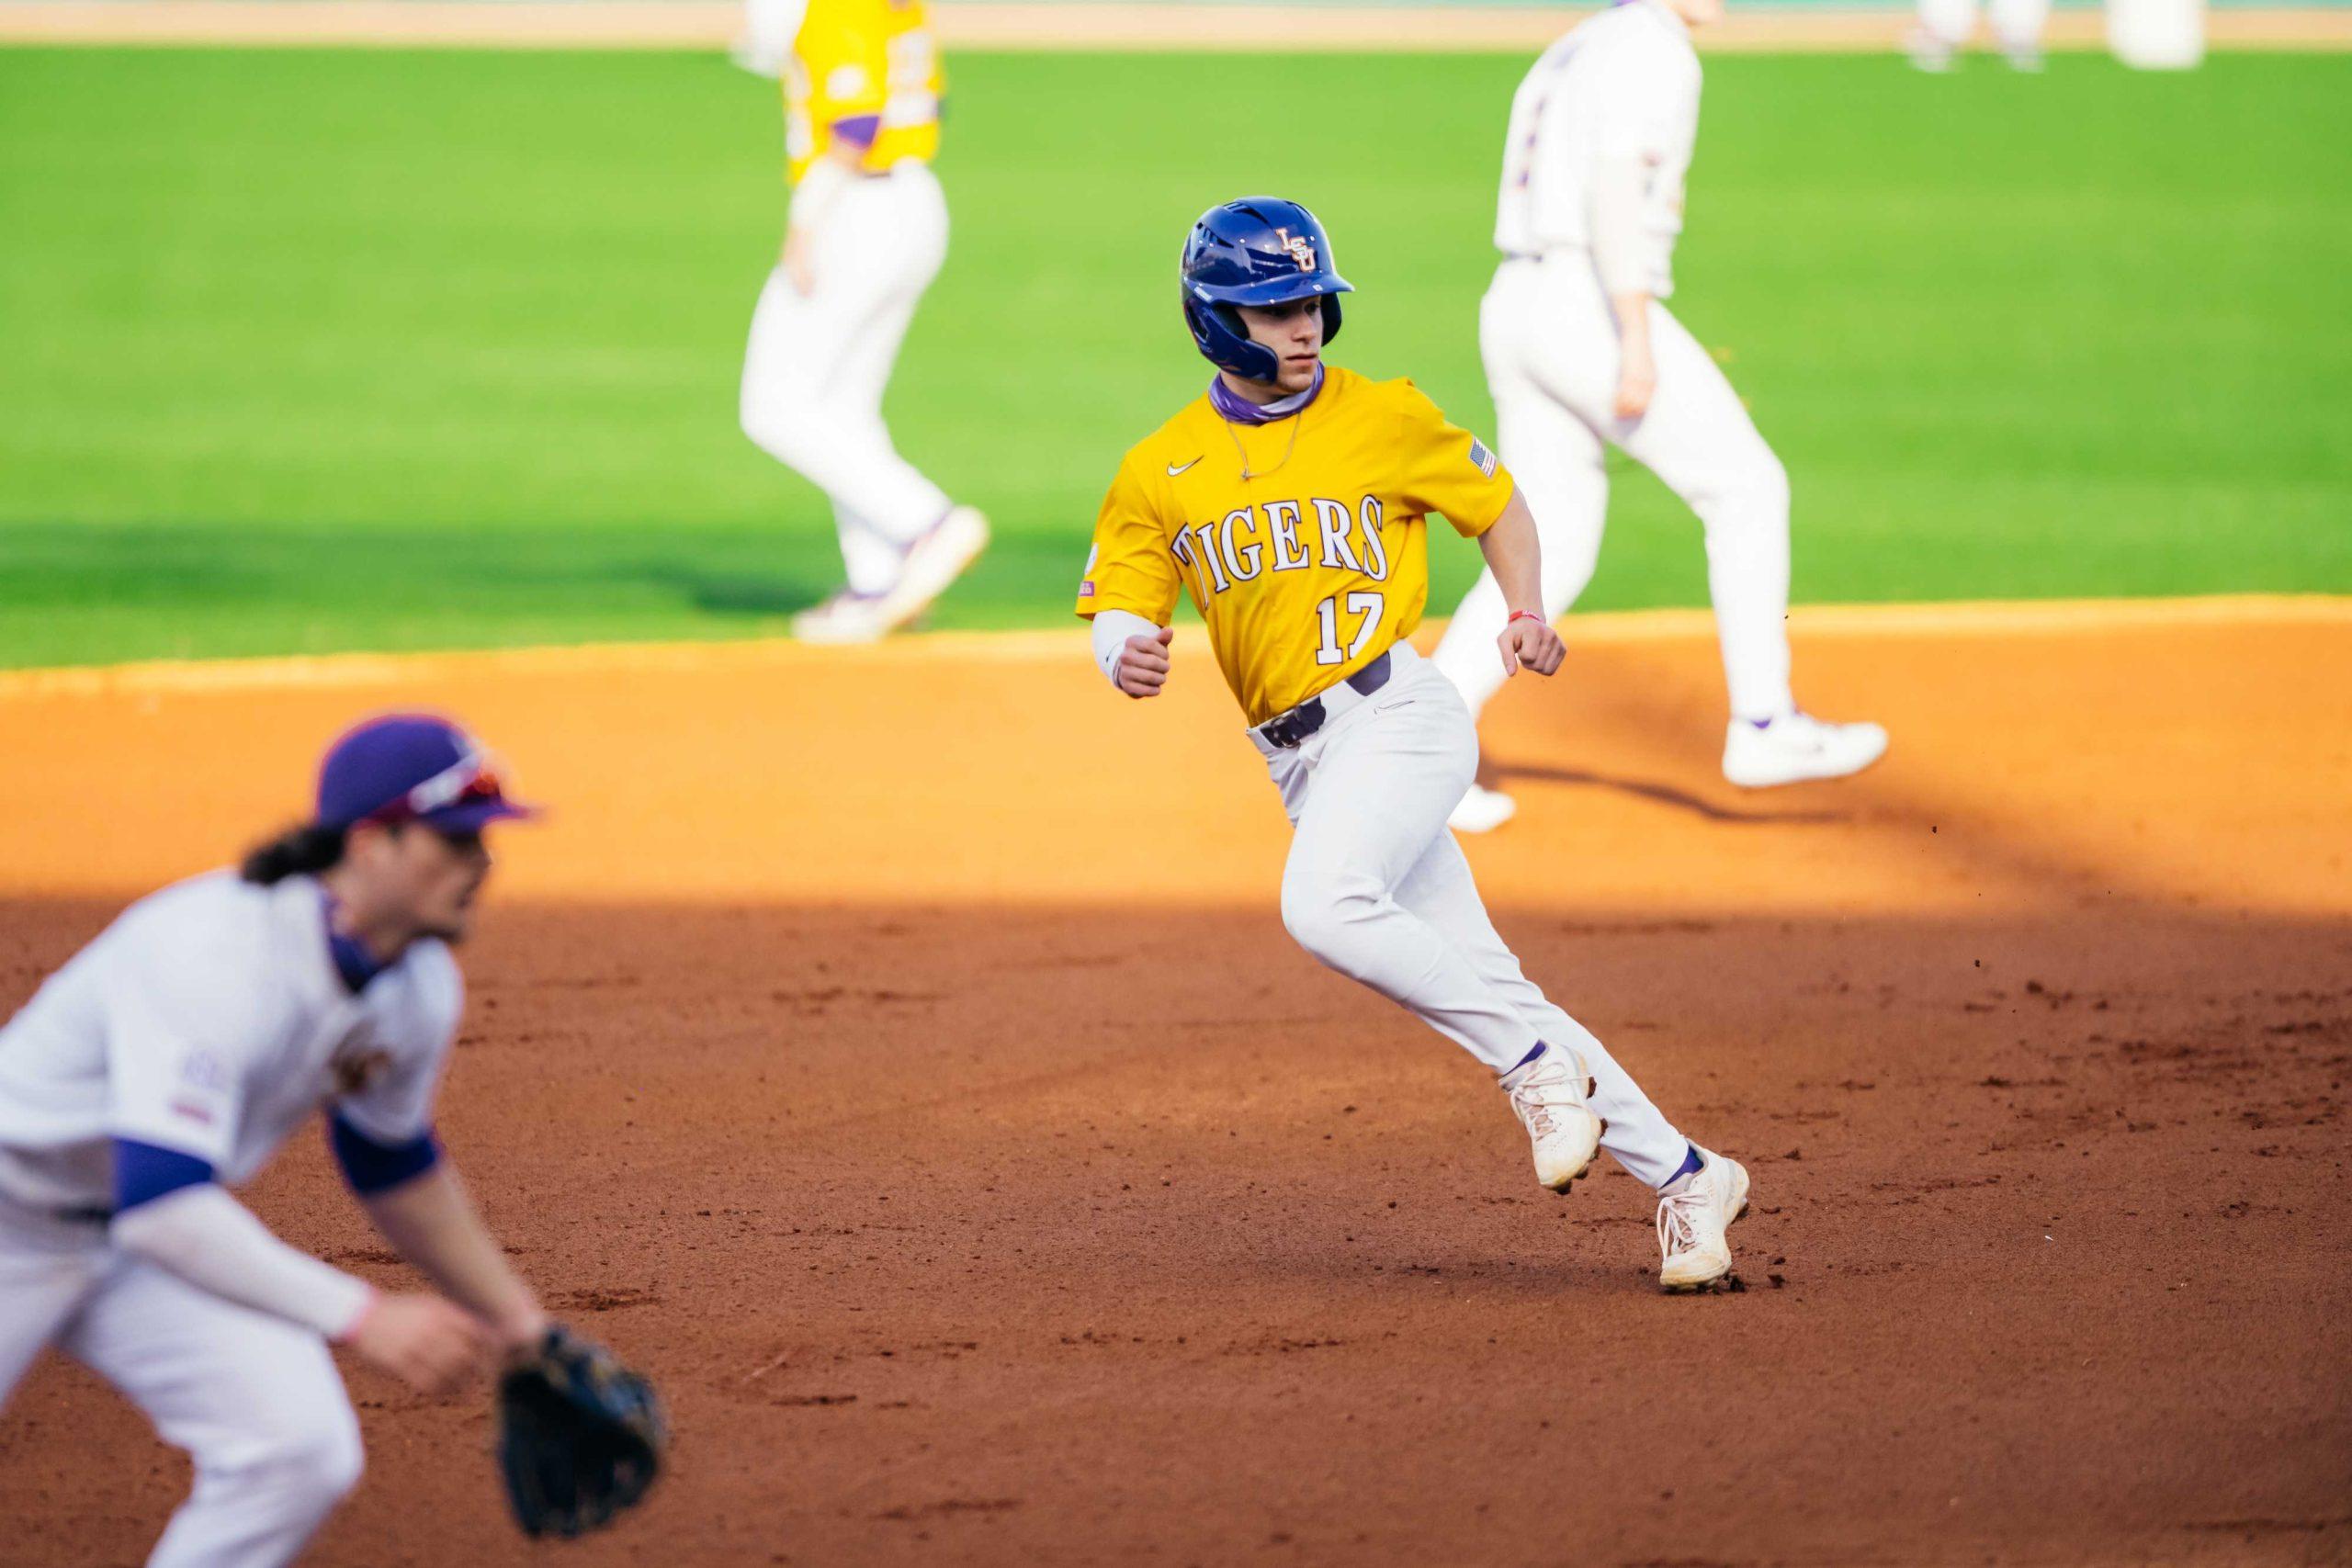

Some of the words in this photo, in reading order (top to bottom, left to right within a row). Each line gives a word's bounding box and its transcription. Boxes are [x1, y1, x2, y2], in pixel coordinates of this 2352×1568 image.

[1275, 229, 1317, 273] LSU
[1170, 494, 1387, 611] TIGERS
[1316, 592, 1384, 665] 17
